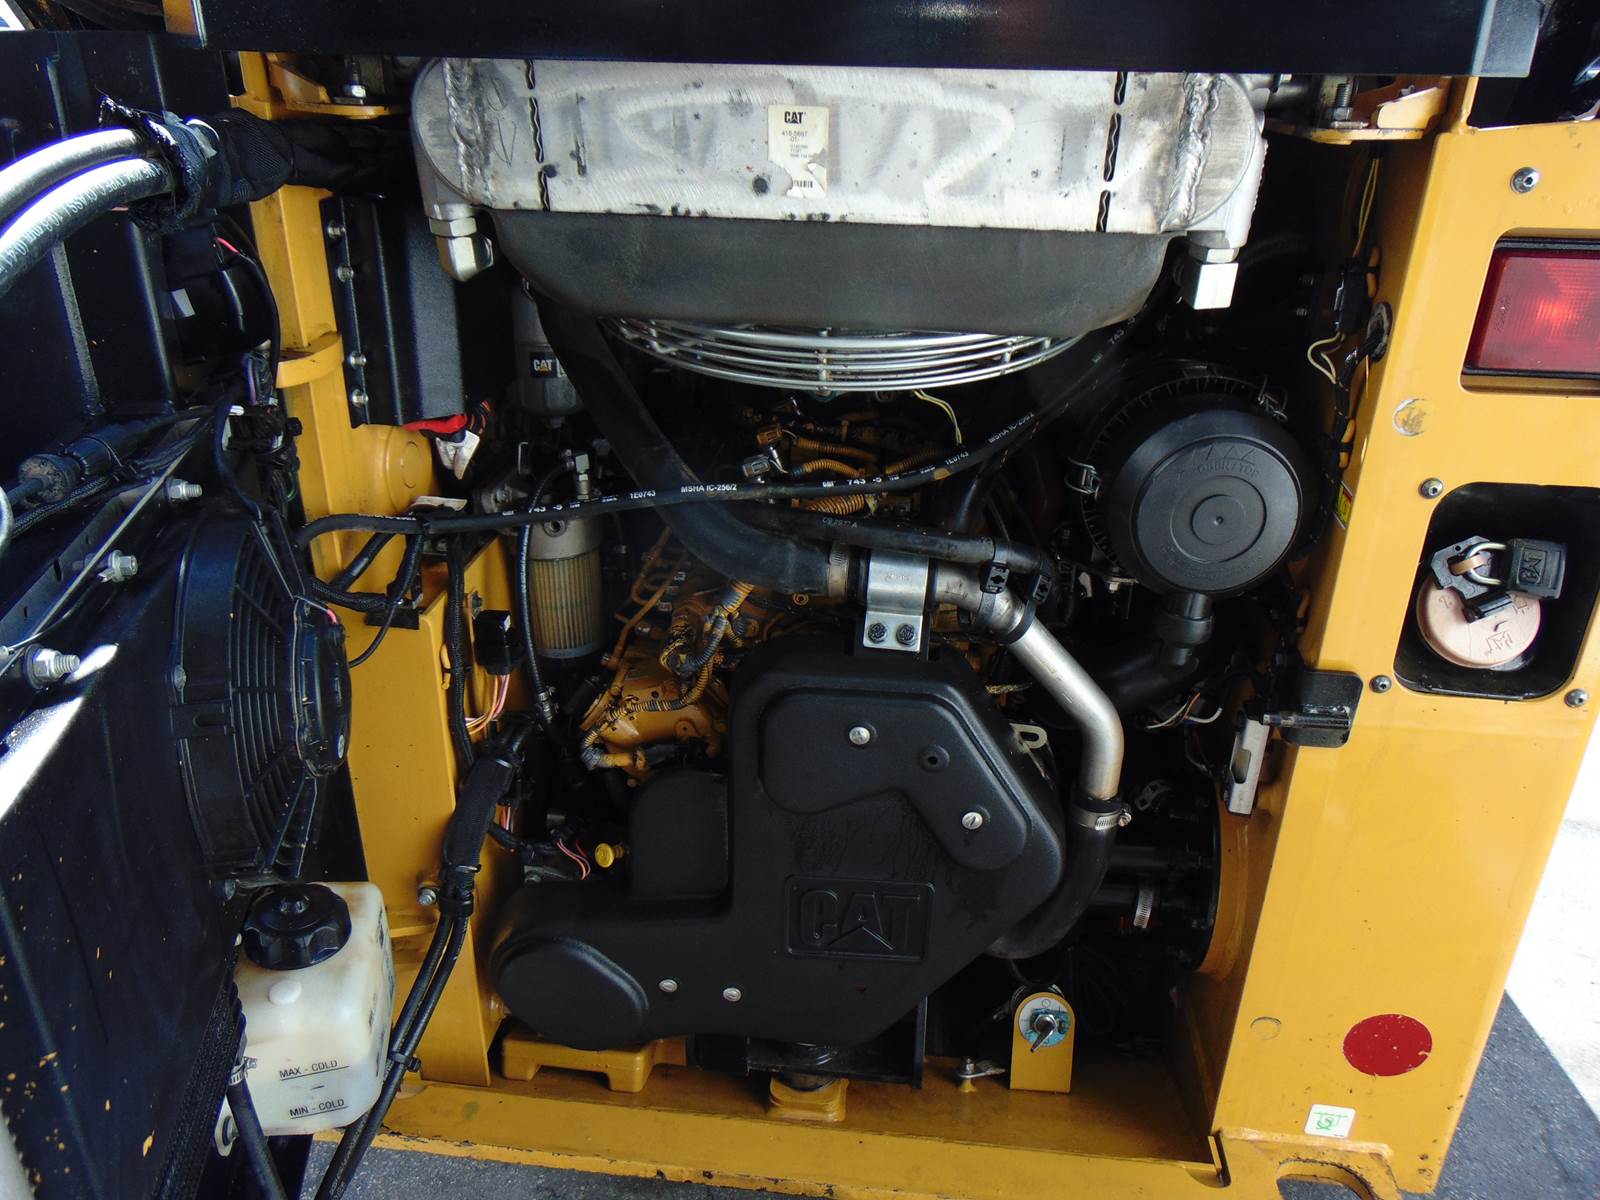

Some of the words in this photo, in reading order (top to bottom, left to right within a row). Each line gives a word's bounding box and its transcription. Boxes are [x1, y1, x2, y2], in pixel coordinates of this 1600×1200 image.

[784, 111, 804, 124] CAT
[533, 359, 552, 372] CAT
[629, 489, 657, 500] 1E0743
[680, 484, 705, 493] MSHA
[800, 887, 920, 951] CAT
[279, 1066, 301, 1078] MAX
[311, 1060, 338, 1072] COLD
[289, 1105, 309, 1117] MIN
[318, 1098, 345, 1111] COLD
